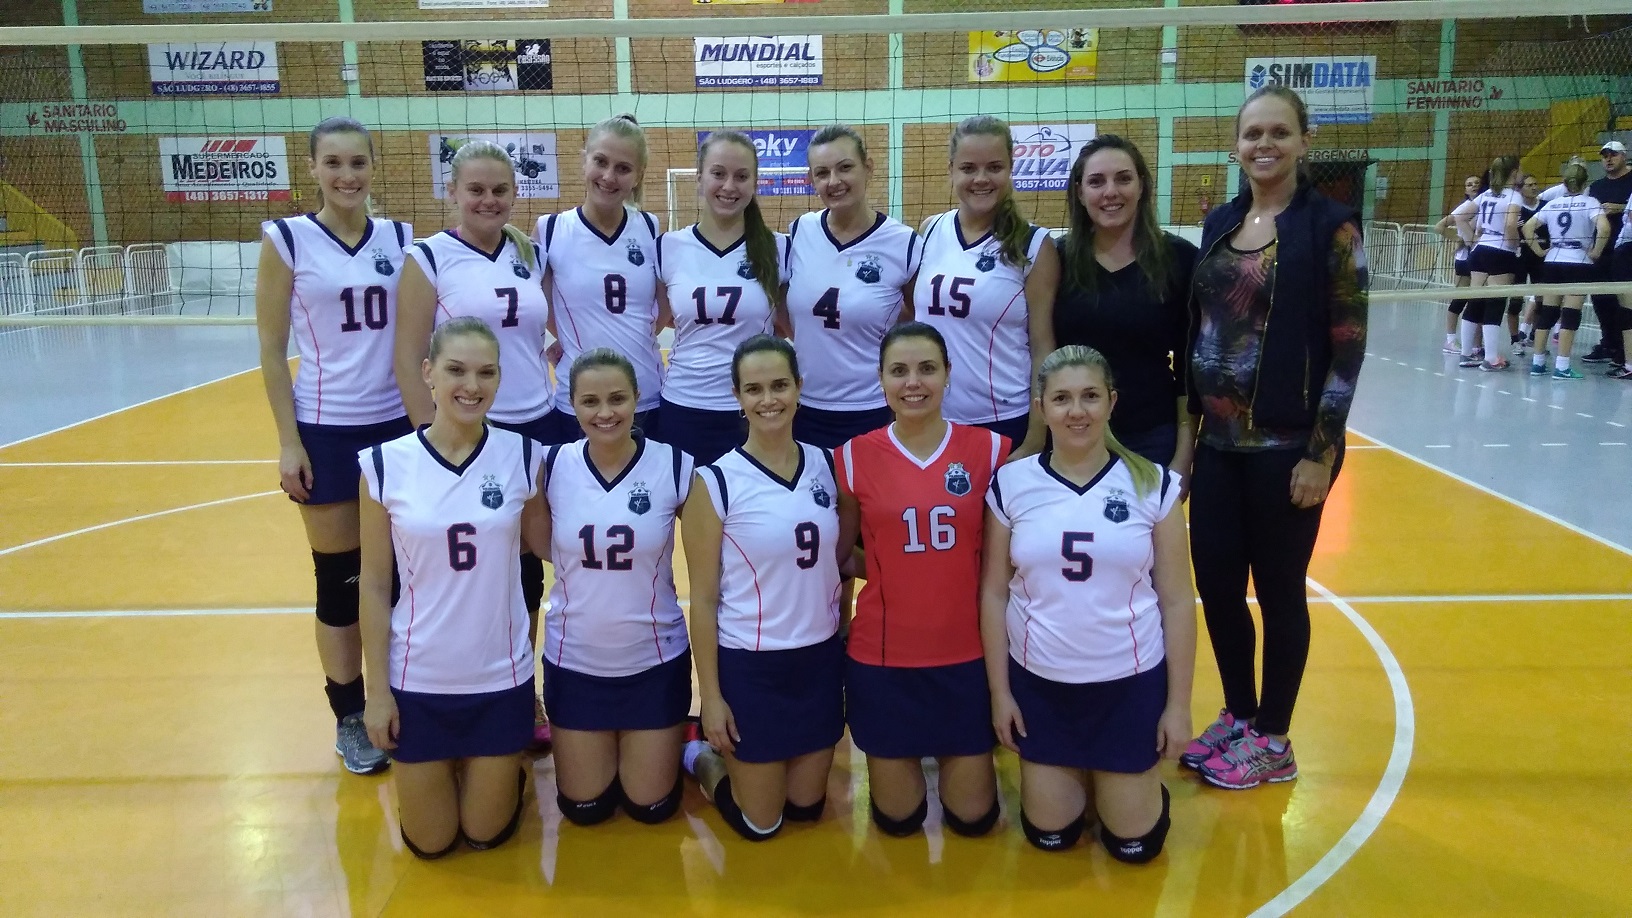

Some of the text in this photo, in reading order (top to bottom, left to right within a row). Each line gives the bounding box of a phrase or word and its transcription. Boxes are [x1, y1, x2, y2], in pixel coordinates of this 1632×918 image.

[164, 50, 265, 70] WIZARD
[700, 42, 816, 61] MUNDIAL
[789, 61, 816, 69] calçados
[1268, 62, 1371, 88] SIMDATA
[157, 83, 174, 95] SÃO
[175, 83, 218, 93] LUDGERO
[698, 77, 716, 85] SÃO
[717, 77, 754, 85] LUDGERO
[760, 77, 777, 85] (48)
[1407, 80, 1484, 95] SANITARIO
[43, 104, 117, 118] SANITARIO
[1406, 95, 1482, 110] FEMININO
[44, 119, 127, 132] MASCULINO
[193, 152, 270, 160] SUPERMERCADO
[753, 133, 798, 157] eky
[1013, 144, 1055, 158] OTO
[1308, 149, 1369, 161] ERGENCIA
[1012, 158, 1070, 177] ILVA
[185, 190, 269, 200] (48) 3657-1312
[1015, 179, 1067, 189] 3657-1007
[1481, 200, 1497, 225] 17
[1557, 211, 1572, 236] 9
[603, 273, 628, 315] 8
[928, 273, 976, 319] 15
[340, 285, 389, 333] 10
[494, 286, 519, 328] 7
[691, 286, 743, 326] 17
[812, 287, 841, 330] 4
[901, 505, 957, 554] 16
[446, 522, 477, 572] 6
[578, 524, 635, 571] 12
[794, 521, 820, 570] 9
[1060, 530, 1095, 583] 5
